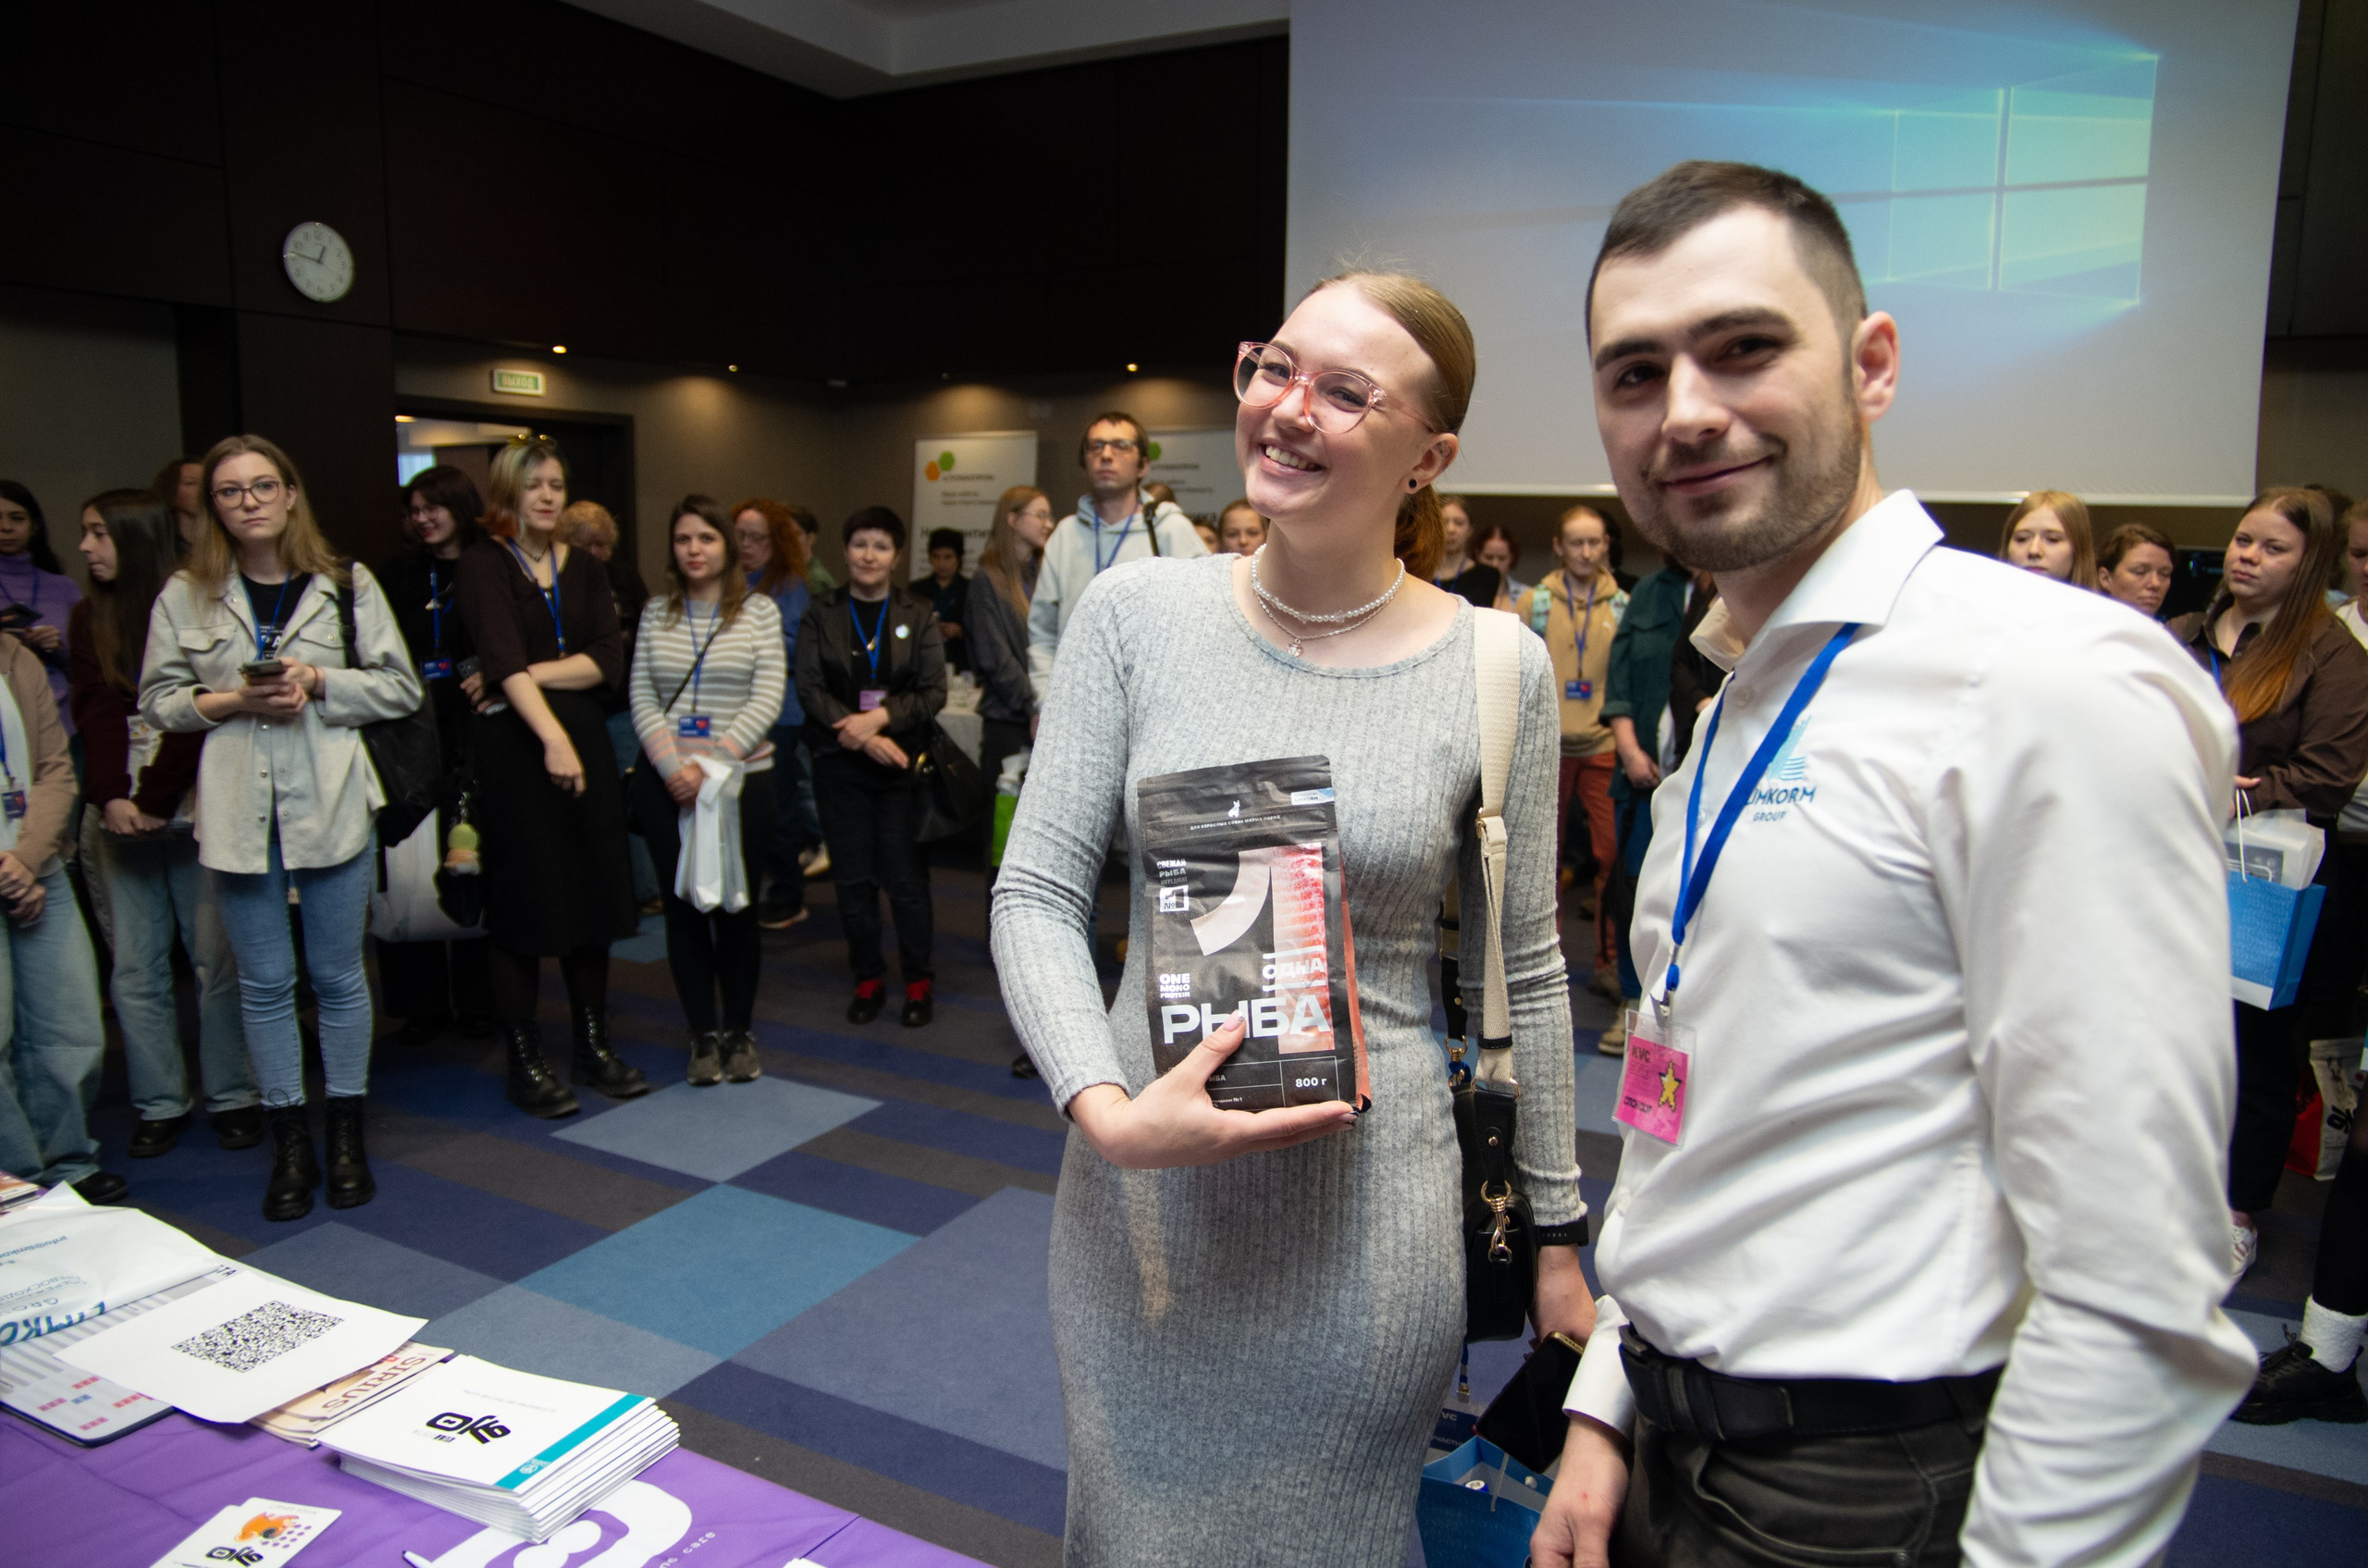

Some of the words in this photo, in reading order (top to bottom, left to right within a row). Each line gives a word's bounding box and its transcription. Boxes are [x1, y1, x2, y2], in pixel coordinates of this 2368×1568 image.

[501, 374, 535, 389] ВЫХОД
[1746, 785, 1817, 805] IMKORM
[1753, 811, 1786, 821] GROUP
[1157, 858, 1187, 869] СВЕЖАЯ
[1159, 868, 1187, 878] РЫБА
[1263, 957, 1326, 981] ОДНА
[1160, 973, 1190, 985] ONE
[1160, 983, 1190, 993] MONO
[1161, 994, 1331, 1044] РЫБА
[1295, 1078, 1319, 1088] 800
[1321, 1077, 1327, 1086] г
[322, 1356, 426, 1409] SIRIUS
[1441, 1412, 1458, 1422] VC
[682, 1531, 716, 1554] care
